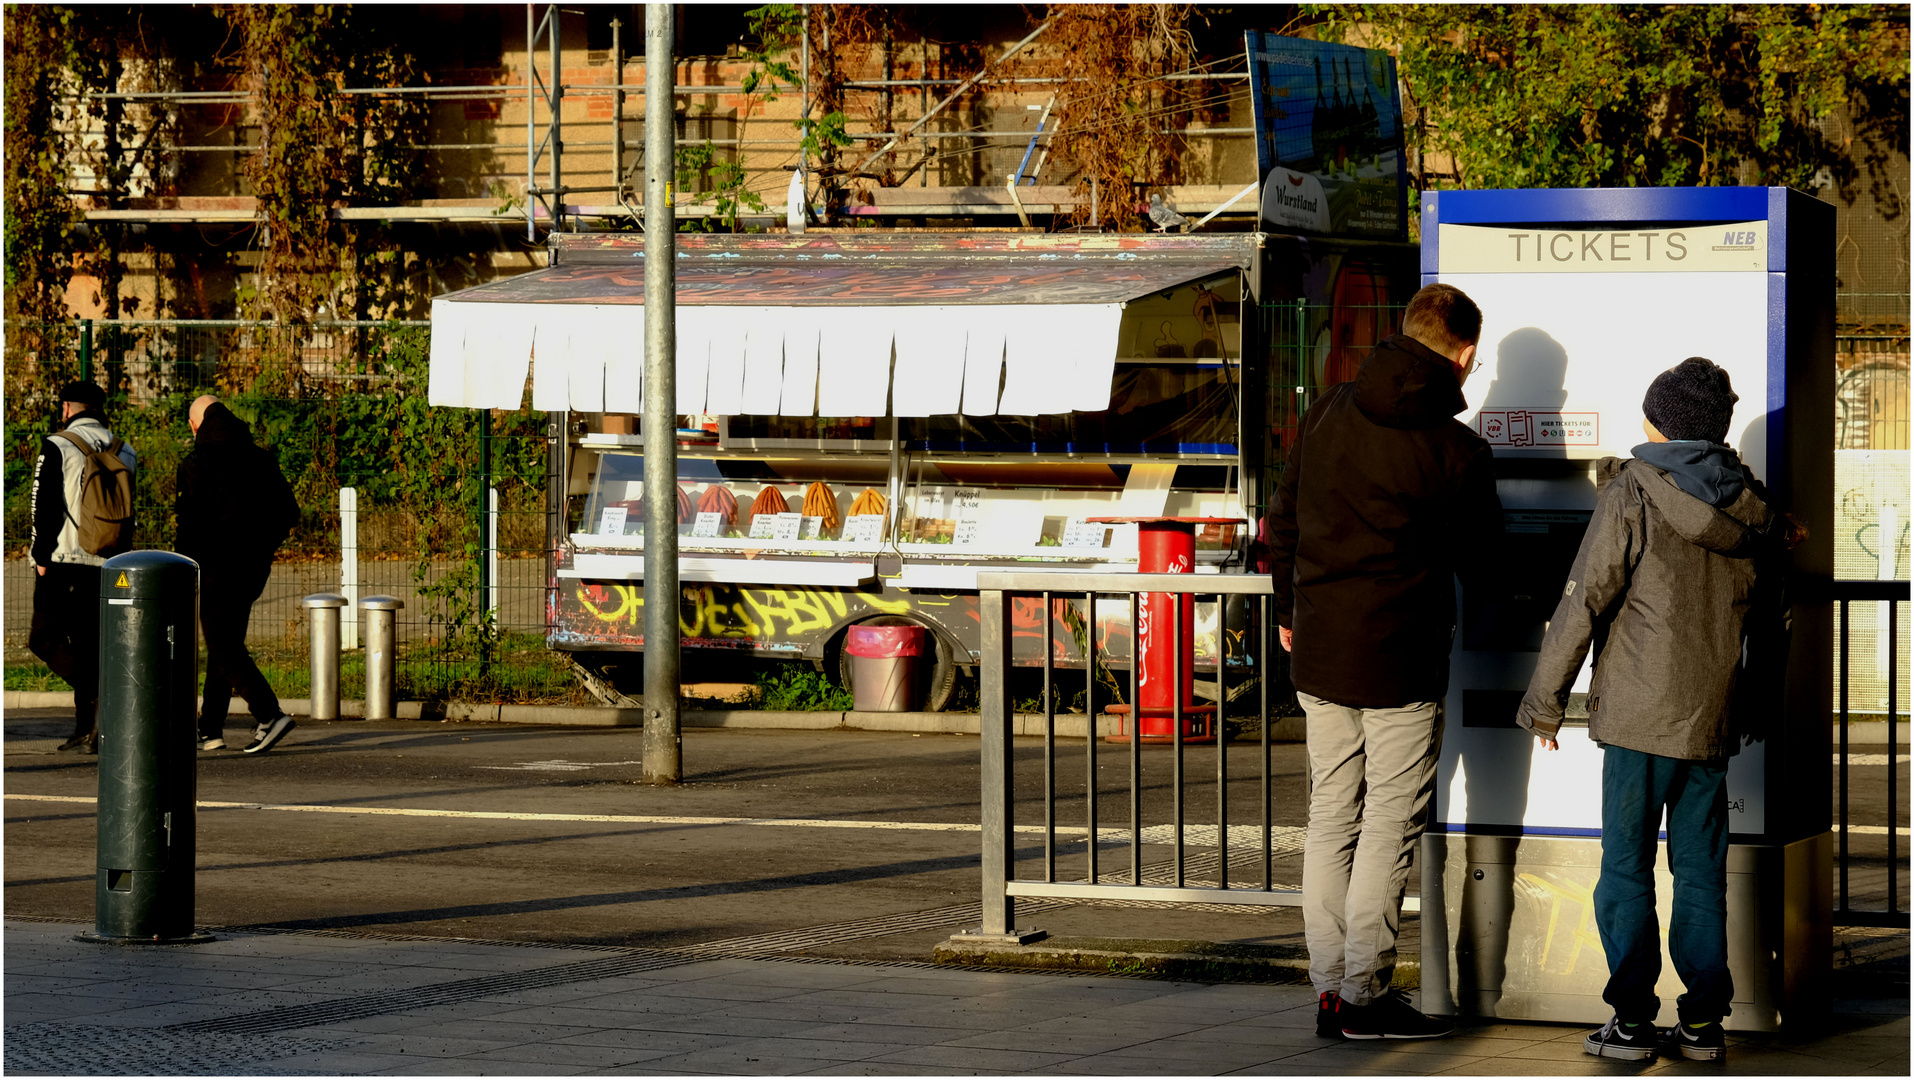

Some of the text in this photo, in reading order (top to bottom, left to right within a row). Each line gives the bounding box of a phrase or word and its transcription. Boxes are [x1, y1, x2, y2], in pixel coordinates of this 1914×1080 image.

[1276, 185, 1317, 213] Wurstland
[1508, 232, 1688, 262] TICKETS
[1723, 231, 1757, 246] NEB
[954, 490, 981, 500] Knüppel
